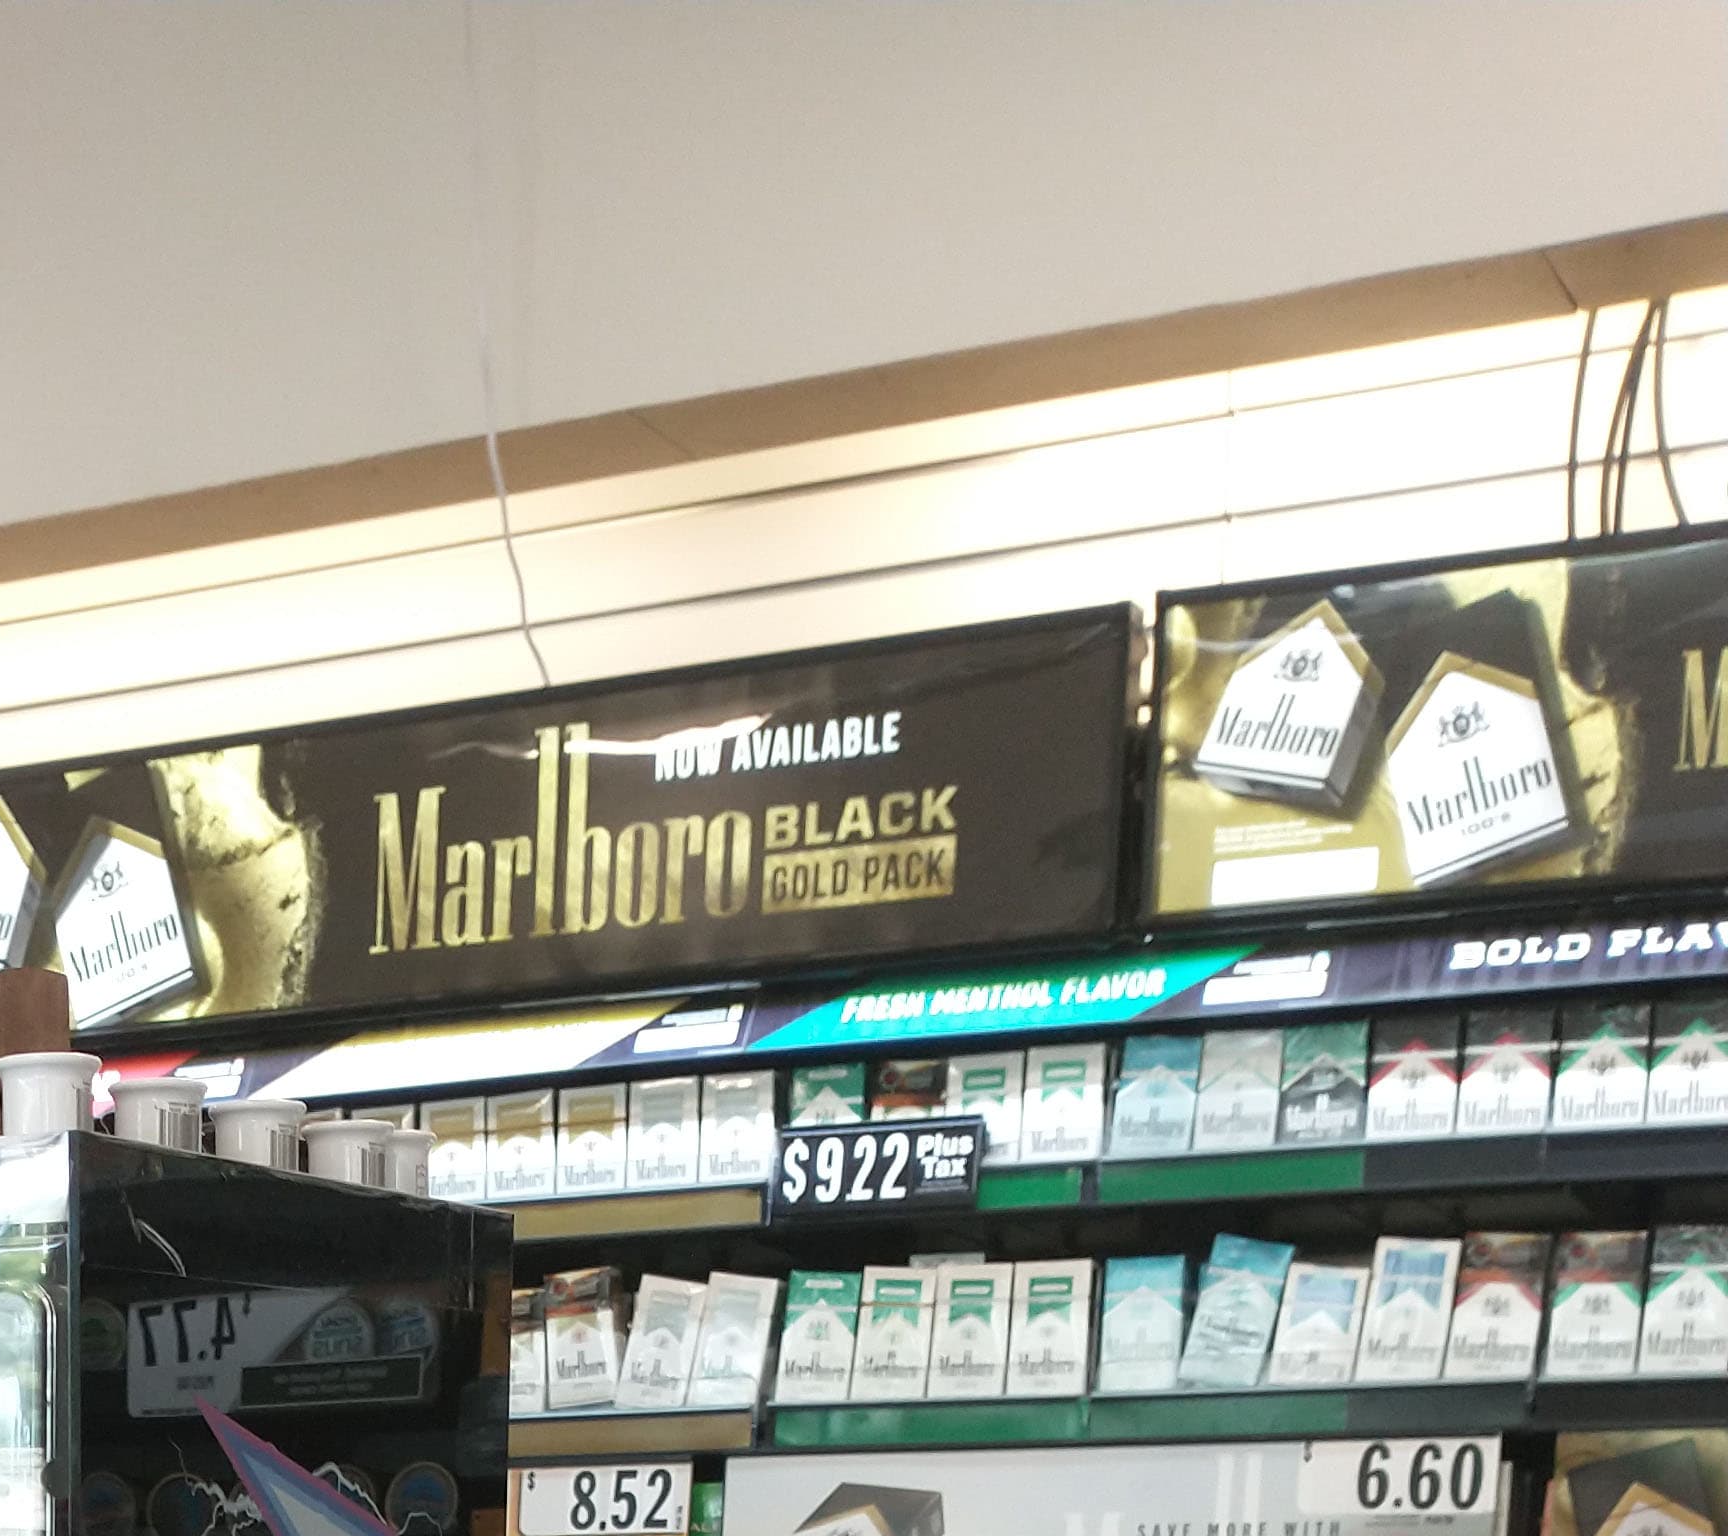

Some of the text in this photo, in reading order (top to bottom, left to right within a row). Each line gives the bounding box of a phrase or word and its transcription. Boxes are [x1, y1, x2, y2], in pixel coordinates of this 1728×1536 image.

[653, 712, 903, 782] NOW AVAILABLE
[1216, 692, 1340, 760] Marlboro
[762, 786, 958, 850] BLACK
[1406, 756, 1554, 837] Marlboro
[369, 722, 753, 955] Marlboro
[771, 846, 948, 902] GOLD PACK
[1449, 932, 1591, 970] BOLD
[928, 980, 1056, 1018] MENTHOL
[1058, 968, 1166, 1005] FLAVOR
[917, 1133, 973, 1158] Plus
[922, 1157, 967, 1179] Tax
[570, 1469, 672, 1531] 8.52
[1357, 1441, 1484, 1511] 6.60
